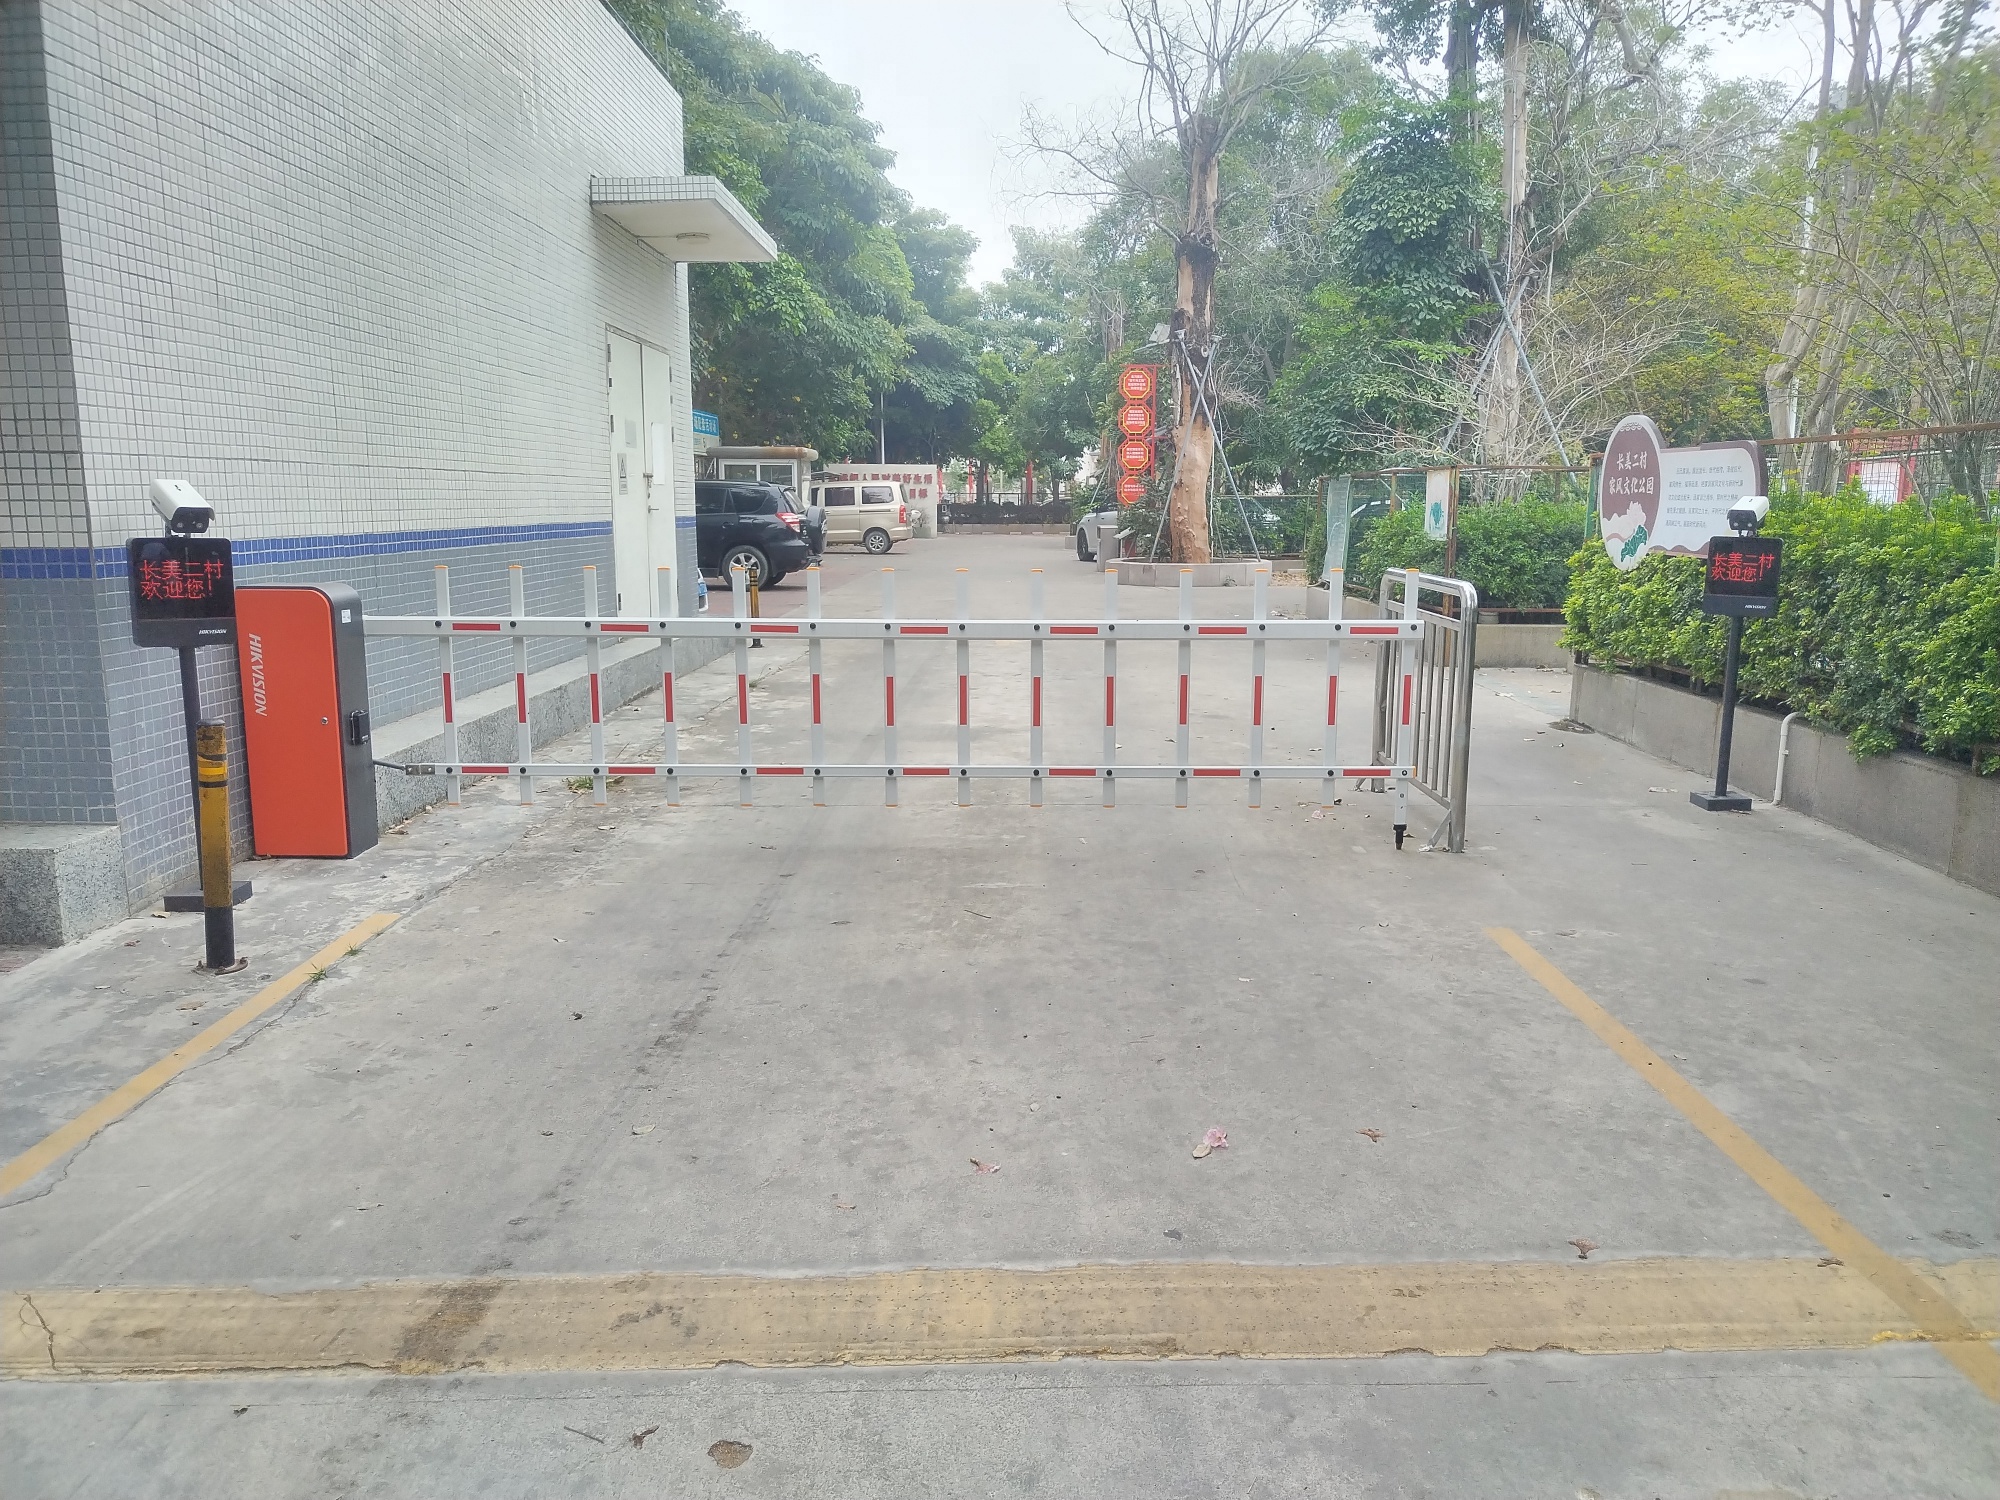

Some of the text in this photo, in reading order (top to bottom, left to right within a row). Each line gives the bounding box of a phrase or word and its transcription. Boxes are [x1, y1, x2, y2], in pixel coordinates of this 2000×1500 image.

[1616, 450, 1648, 471] 长美二村
[1608, 476, 1654, 495] 家风文化公园
[139, 558, 224, 580] 长美二村
[1712, 551, 1775, 569] 长美二村
[248, 632, 268, 717] HIKVISION
